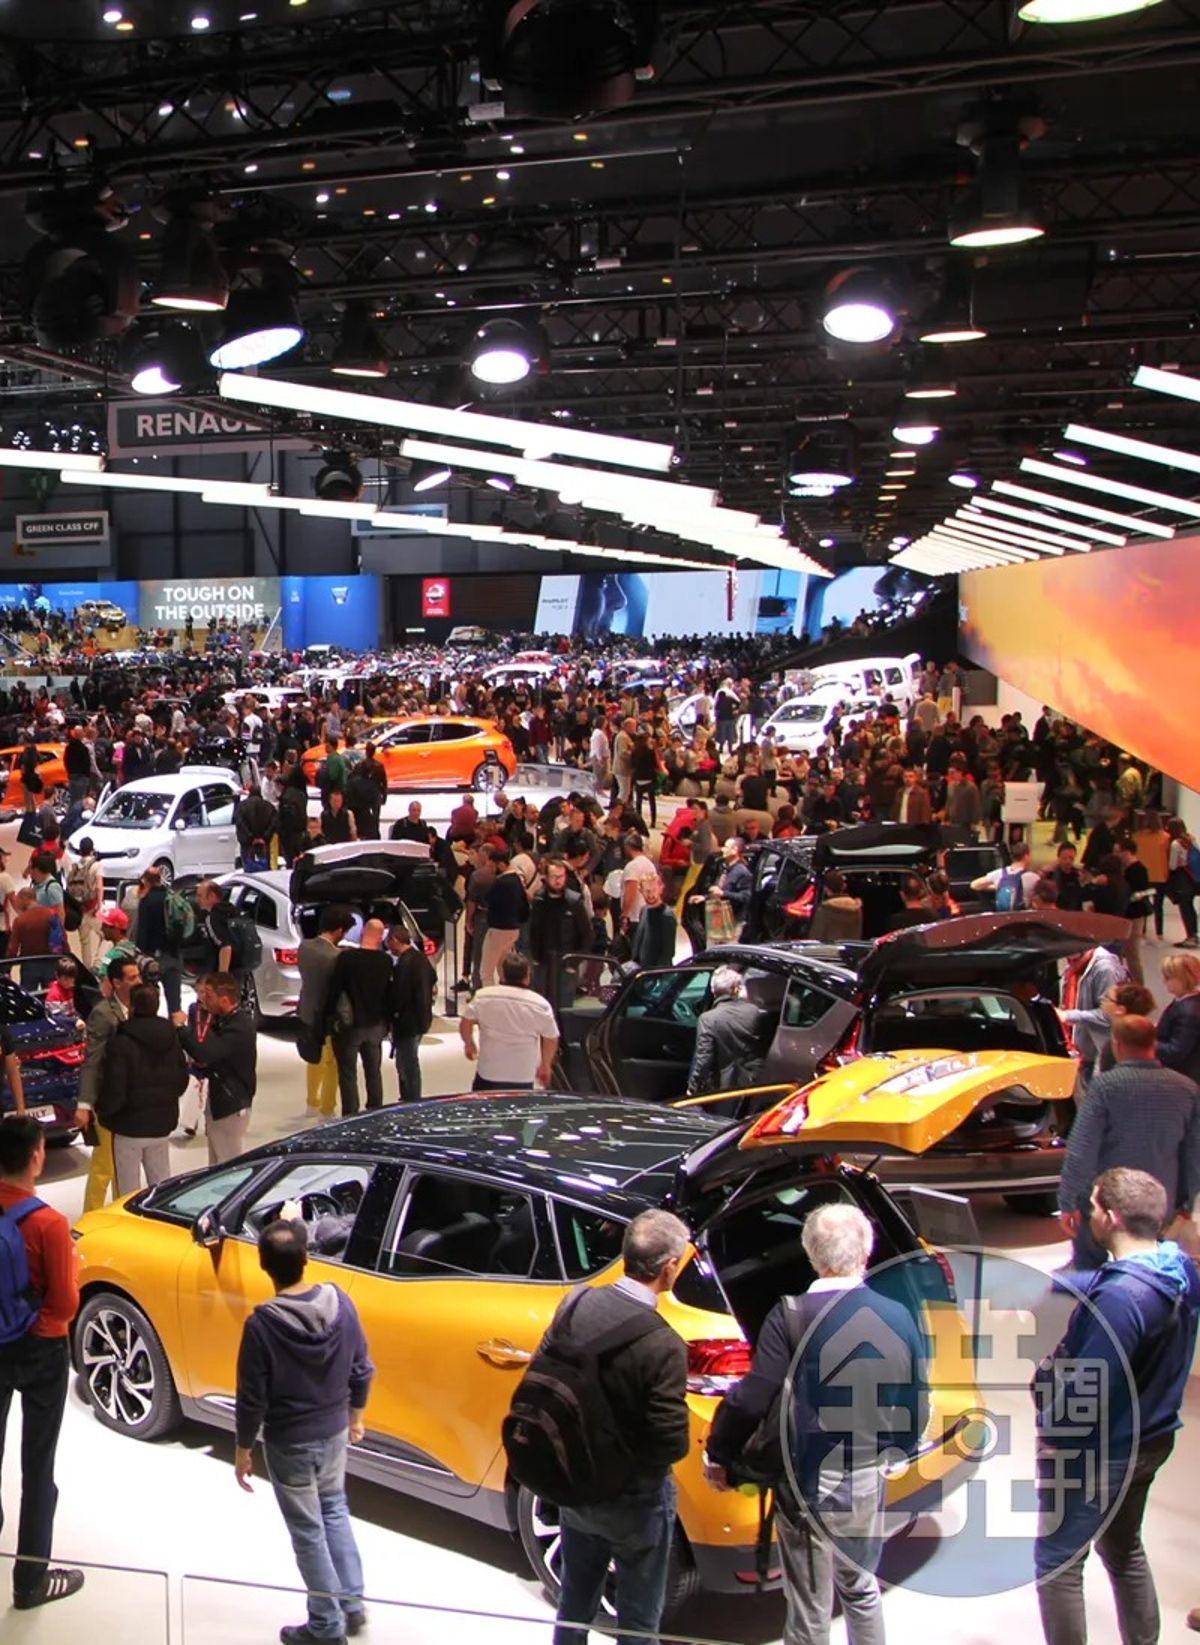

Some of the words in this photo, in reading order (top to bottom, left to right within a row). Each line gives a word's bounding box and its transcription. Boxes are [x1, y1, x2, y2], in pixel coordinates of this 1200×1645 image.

[137, 411, 261, 438] RENAU
[25, 524, 55, 533] GREEN
[55, 523, 82, 531] CLASS
[163, 586, 225, 602] TOUGH
[228, 585, 254, 600] ON
[155, 605, 188, 620] THE
[190, 603, 264, 621] OUTSIDE
